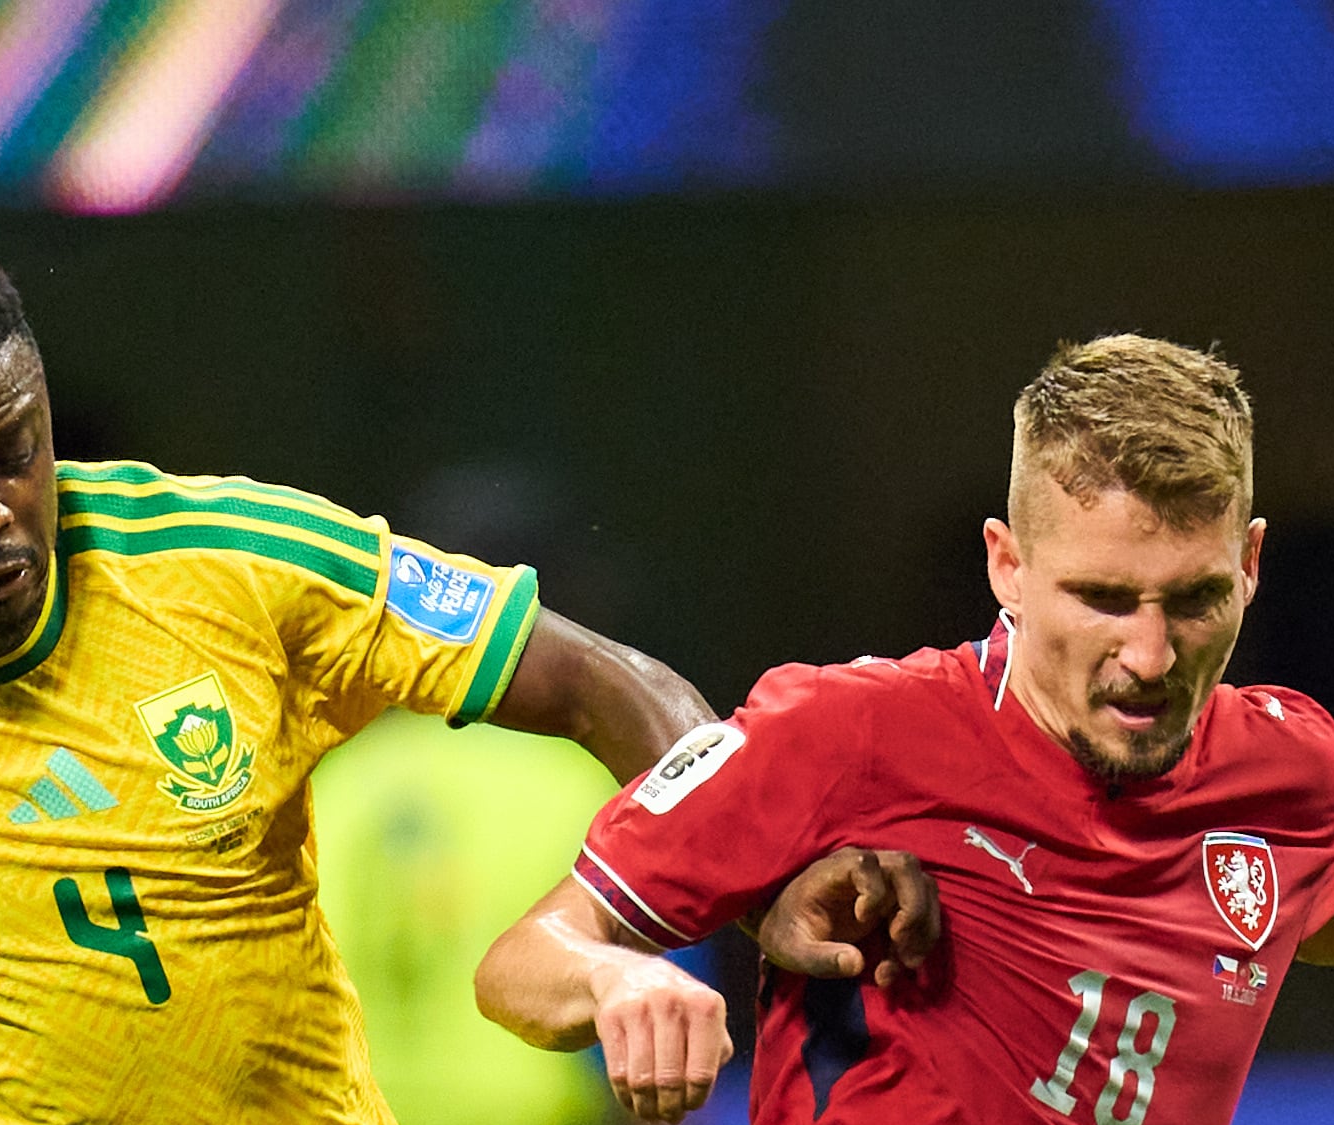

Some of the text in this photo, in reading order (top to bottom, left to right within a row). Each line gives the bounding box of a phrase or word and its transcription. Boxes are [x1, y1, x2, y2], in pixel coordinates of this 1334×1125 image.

[439, 569, 472, 616] PEACE
[186, 776, 249, 809] SOUTH AFRICA
[53, 866, 172, 1005] 4
